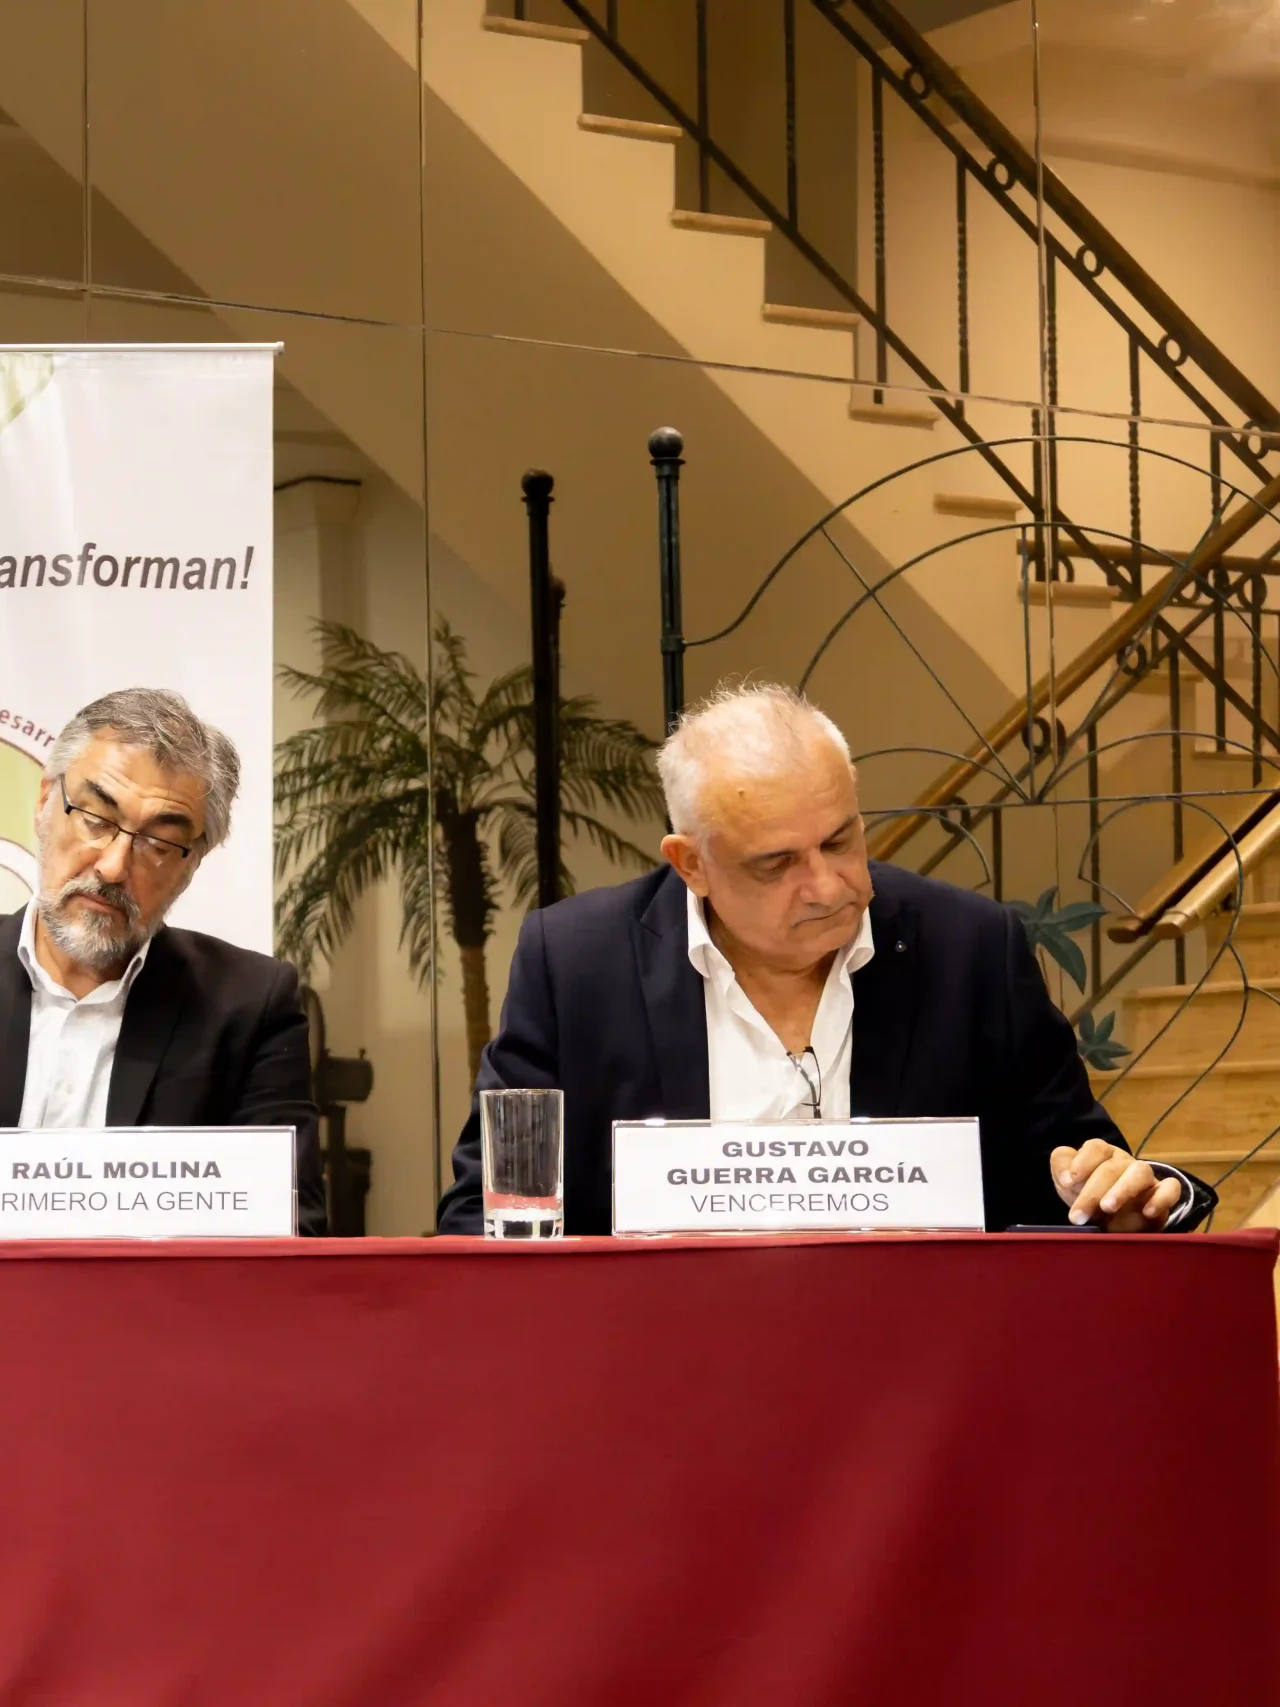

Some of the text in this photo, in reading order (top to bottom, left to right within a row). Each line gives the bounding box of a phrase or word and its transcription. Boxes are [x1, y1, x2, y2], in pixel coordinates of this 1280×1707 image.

[722, 1139, 869, 1158] GUSTAVO
[12, 1157, 221, 1180] RAÚL MOLINA
[667, 1162, 929, 1186] GUERRA GARCÍA
[117, 1191, 149, 1212] LA
[156, 1190, 249, 1212] GENTE
[690, 1193, 890, 1213] VENCEREMOS
